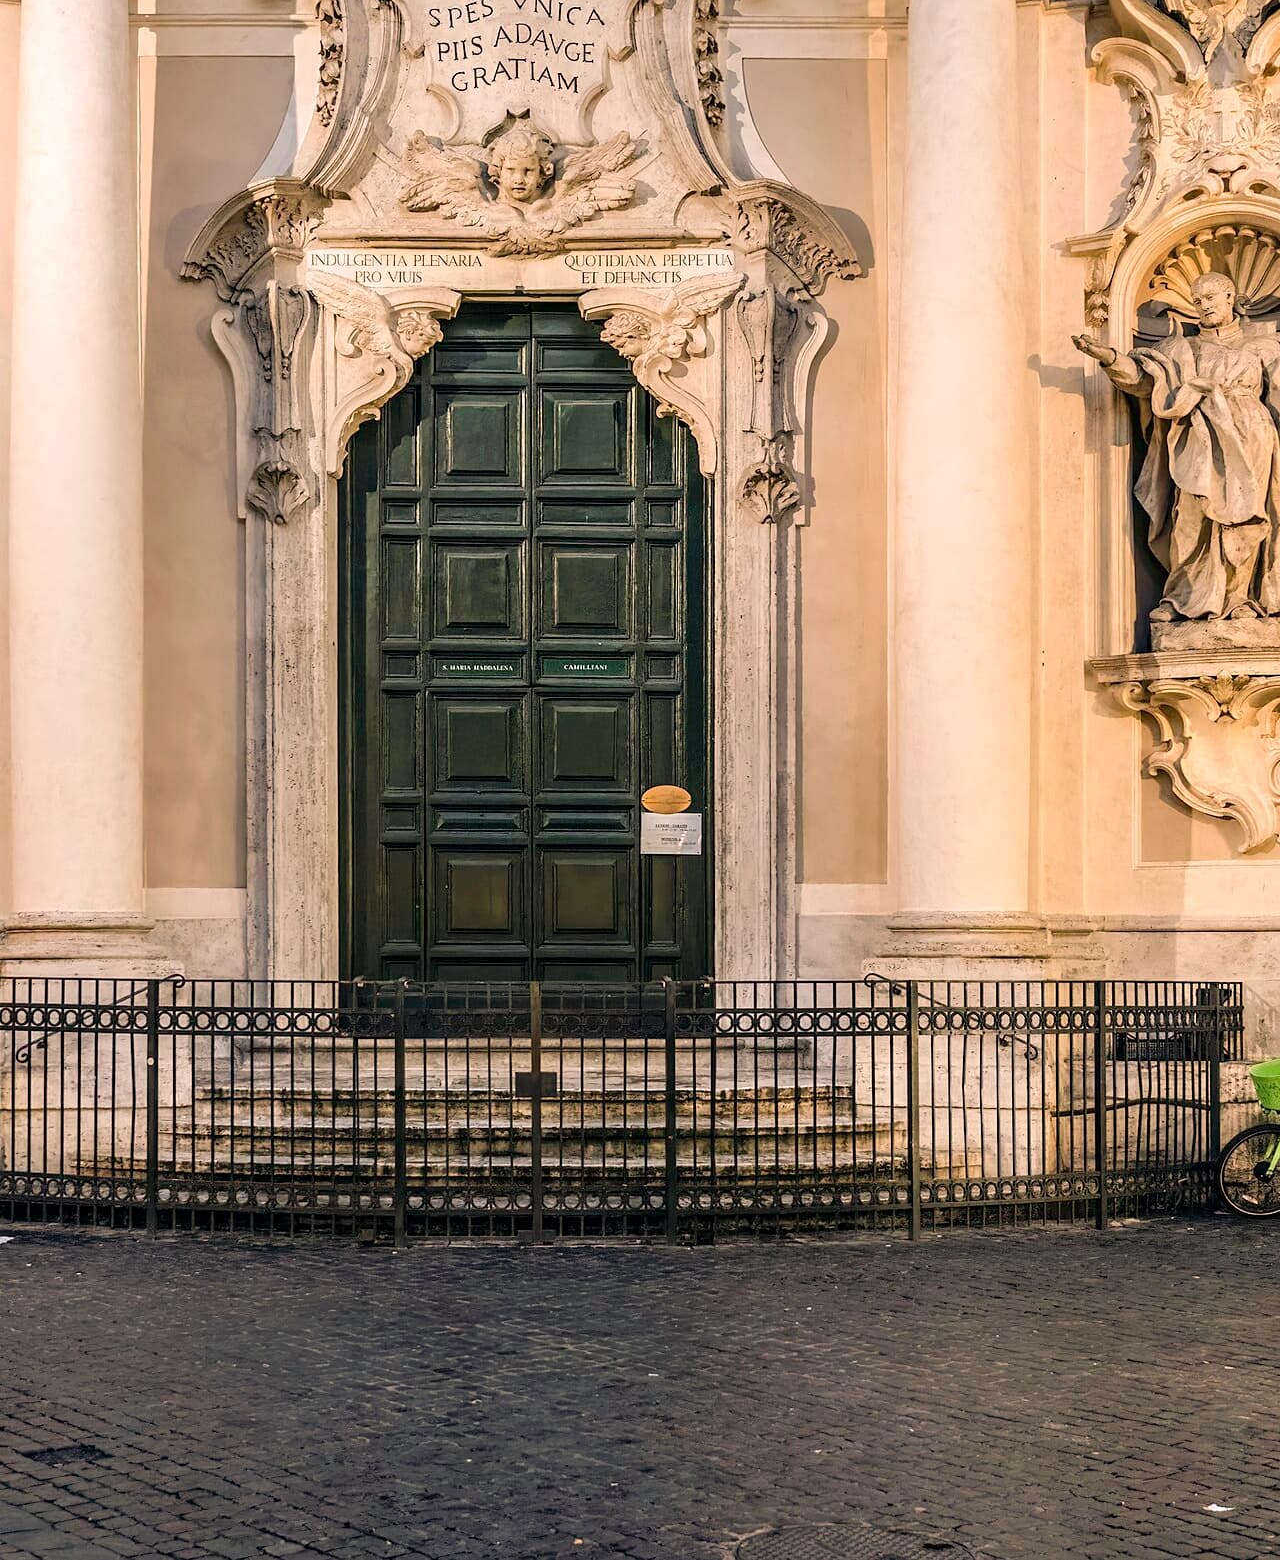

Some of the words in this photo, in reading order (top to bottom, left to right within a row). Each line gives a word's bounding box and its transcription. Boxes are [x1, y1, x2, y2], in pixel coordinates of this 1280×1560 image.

[437, 35, 484, 62] PIIS
[493, 22, 595, 63] ADAVGE
[451, 58, 580, 94] GRATIAM
[311, 253, 408, 267] INDULGENTIA
[413, 254, 483, 267] PLENARIA
[564, 253, 657, 272] QUOTIDIANA
[663, 253, 733, 267] PERPETUA
[355, 270, 382, 284] PRO
[581, 271, 600, 284] ET
[604, 270, 682, 284] DEFUNCTIS
